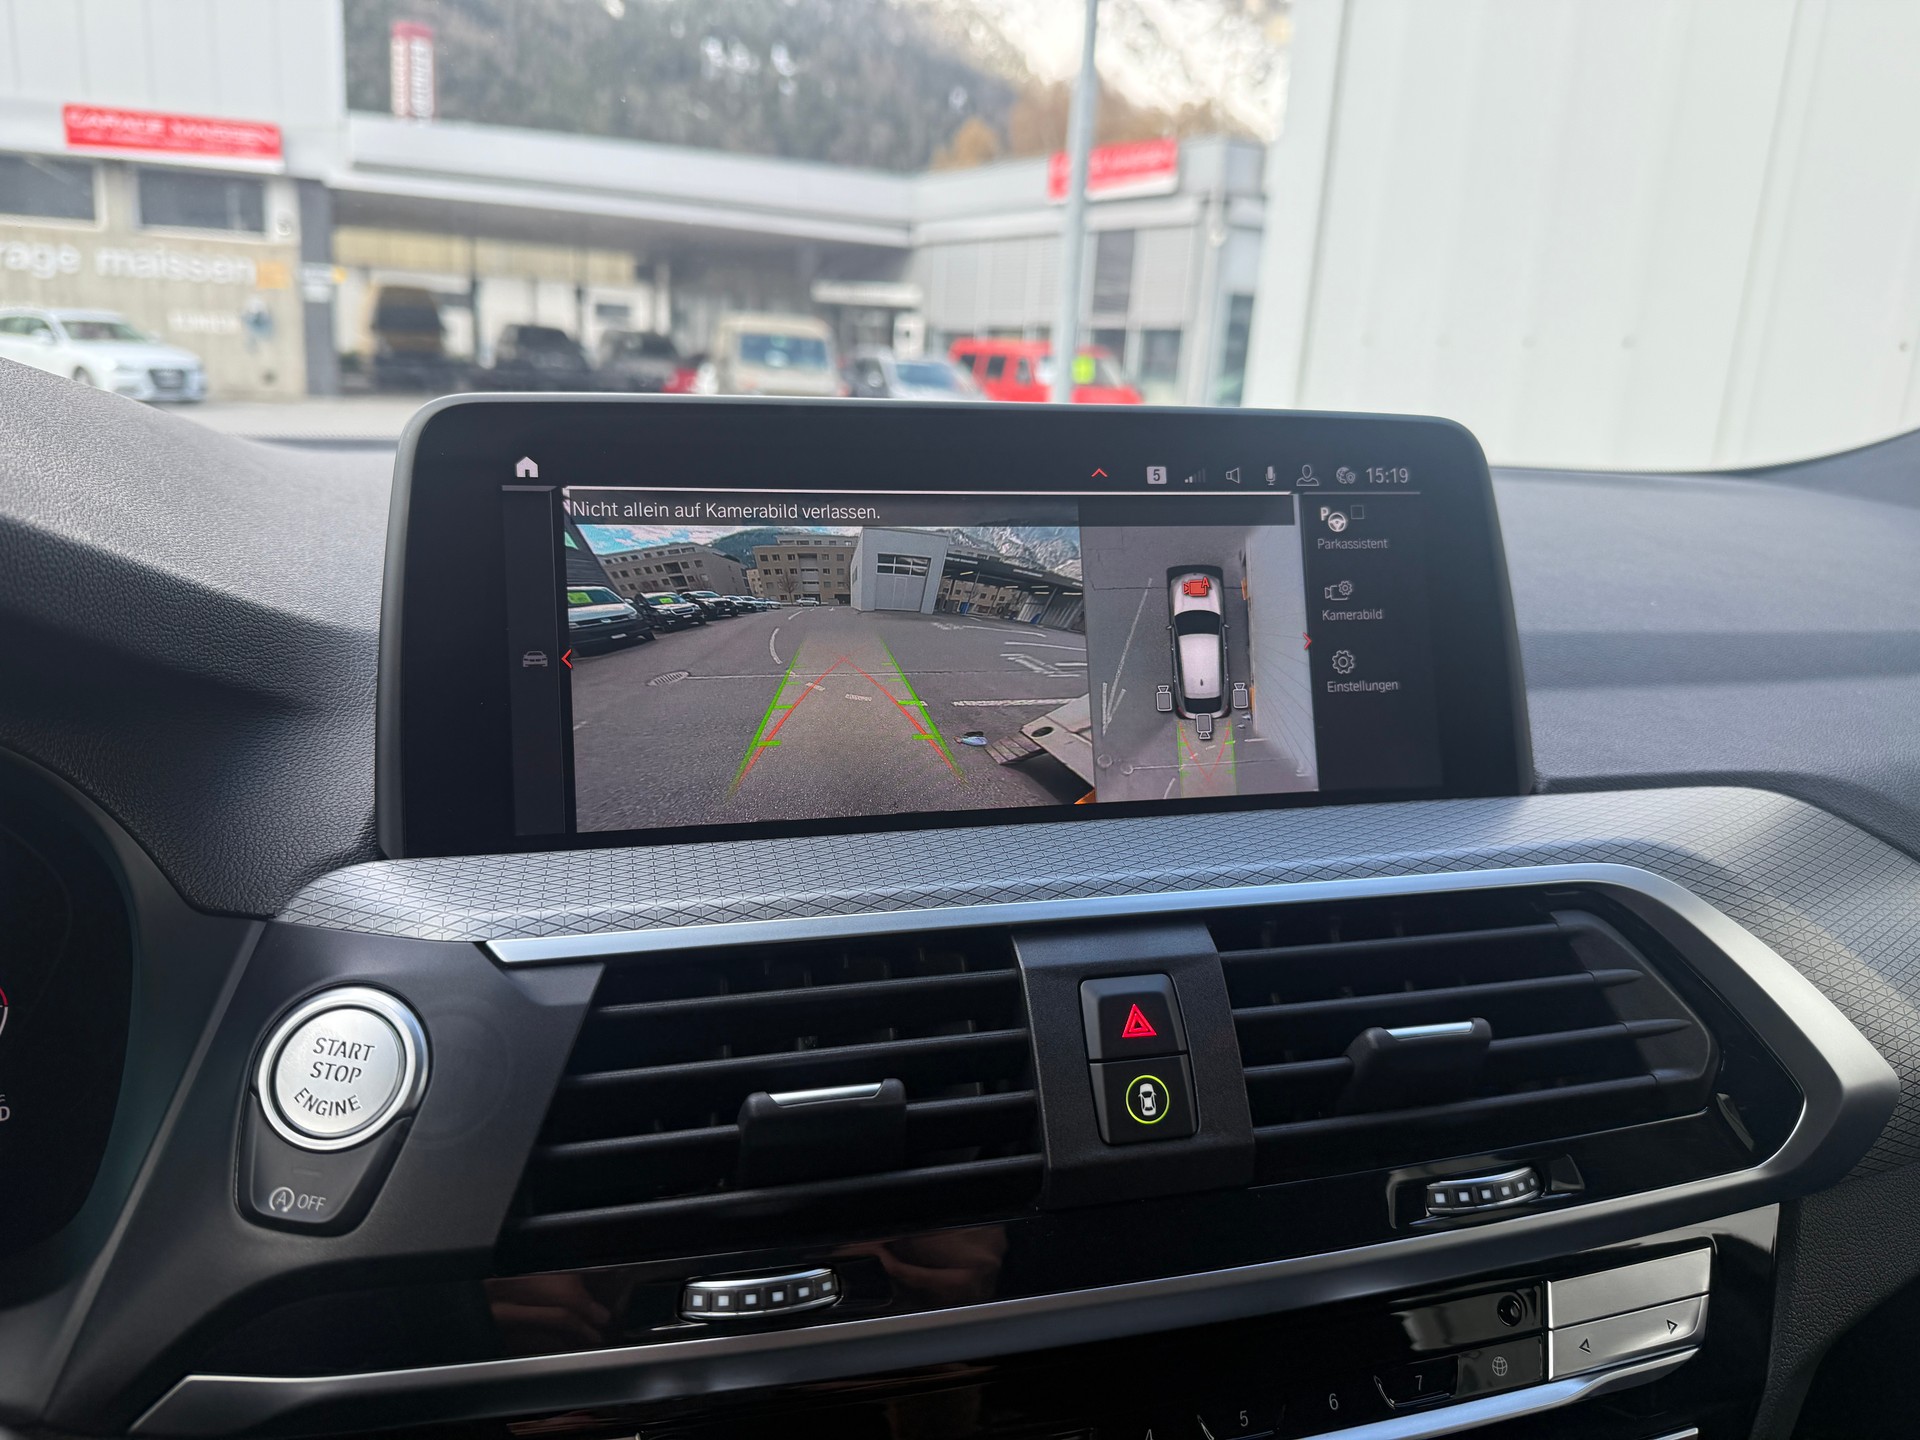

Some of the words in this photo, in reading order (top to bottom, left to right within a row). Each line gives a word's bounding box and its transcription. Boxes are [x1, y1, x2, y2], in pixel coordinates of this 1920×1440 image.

[1365, 467, 1409, 484] 15:19
[572, 500, 618, 518] Nicht
[624, 502, 669, 518] allein
[674, 503, 701, 518] auf
[705, 503, 798, 519] Kamerabild
[802, 505, 881, 520] verlassen.
[1317, 538, 1388, 549] Parkassistent
[1322, 609, 1383, 621] Kamerabild
[1327, 680, 1398, 693] Einstellungen
[312, 1037, 375, 1061] START
[310, 1061, 362, 1083] STOP
[294, 1087, 361, 1116] ENGINE
[297, 1193, 326, 1211] OFF
[1415, 1375, 1423, 1391] 7
[1329, 1393, 1339, 1410] 6
[1239, 1410, 1249, 1427] 5
